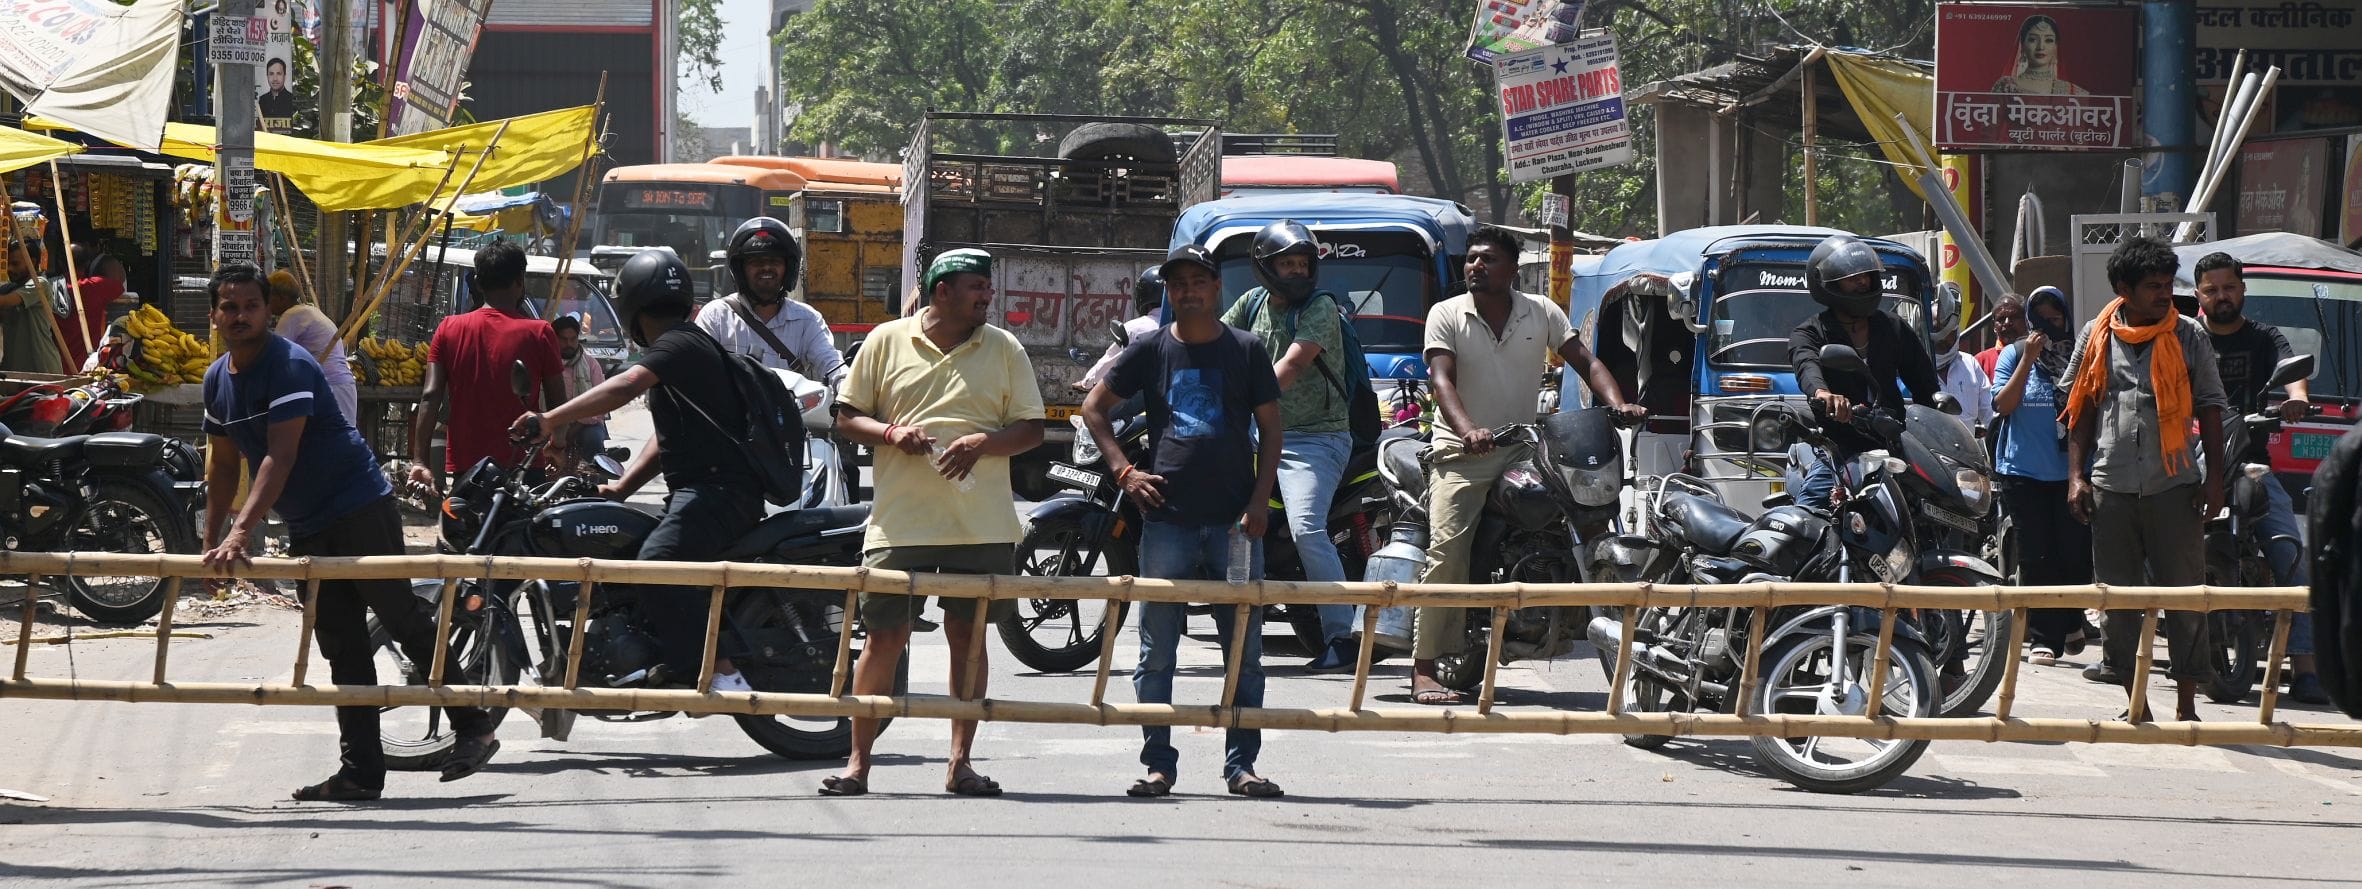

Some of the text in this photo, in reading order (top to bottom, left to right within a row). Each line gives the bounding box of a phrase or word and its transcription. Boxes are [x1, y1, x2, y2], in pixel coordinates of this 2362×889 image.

[2248, 2, 2356, 29] क्लीनिक
[211, 50, 265, 62] 9355 003 006
[1502, 67, 1620, 115] STAR SPARE PARTS
[1954, 96, 2114, 131] वृंदा मेकओवर
[1520, 130, 1539, 138] WATER
[2038, 128, 2066, 141] पार्लर
[2070, 129, 2111, 145] (बुटीक)
[1532, 156, 1546, 166] Ram
[1547, 152, 1567, 163] Plaza,
[1541, 156, 1603, 175] Chauraha, Lucknow
[1004, 290, 1066, 328] जय
[589, 525, 619, 534] Hero
